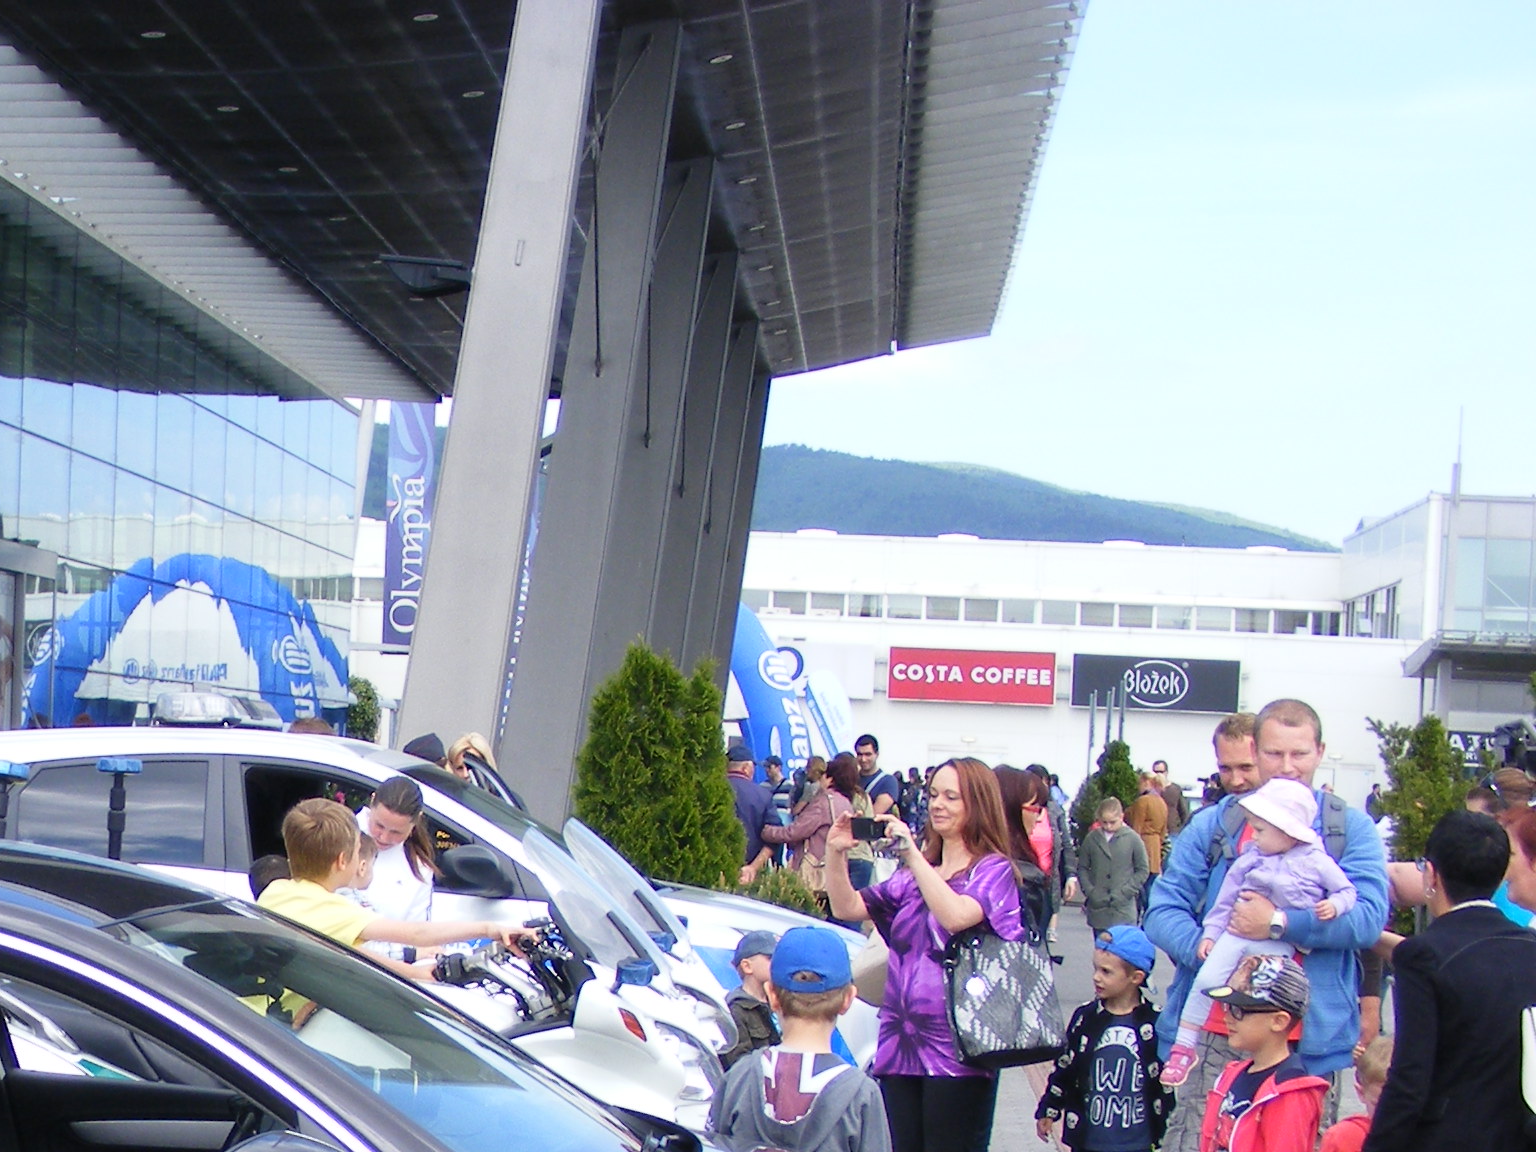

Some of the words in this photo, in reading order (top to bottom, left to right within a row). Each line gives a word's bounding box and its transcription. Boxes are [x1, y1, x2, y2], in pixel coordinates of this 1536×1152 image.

[389, 473, 432, 634] Olympia
[892, 662, 964, 684] COSTA
[970, 665, 1052, 687] COFFEE
[1092, 1057, 1145, 1092] WE
[1088, 1094, 1145, 1128] OME
